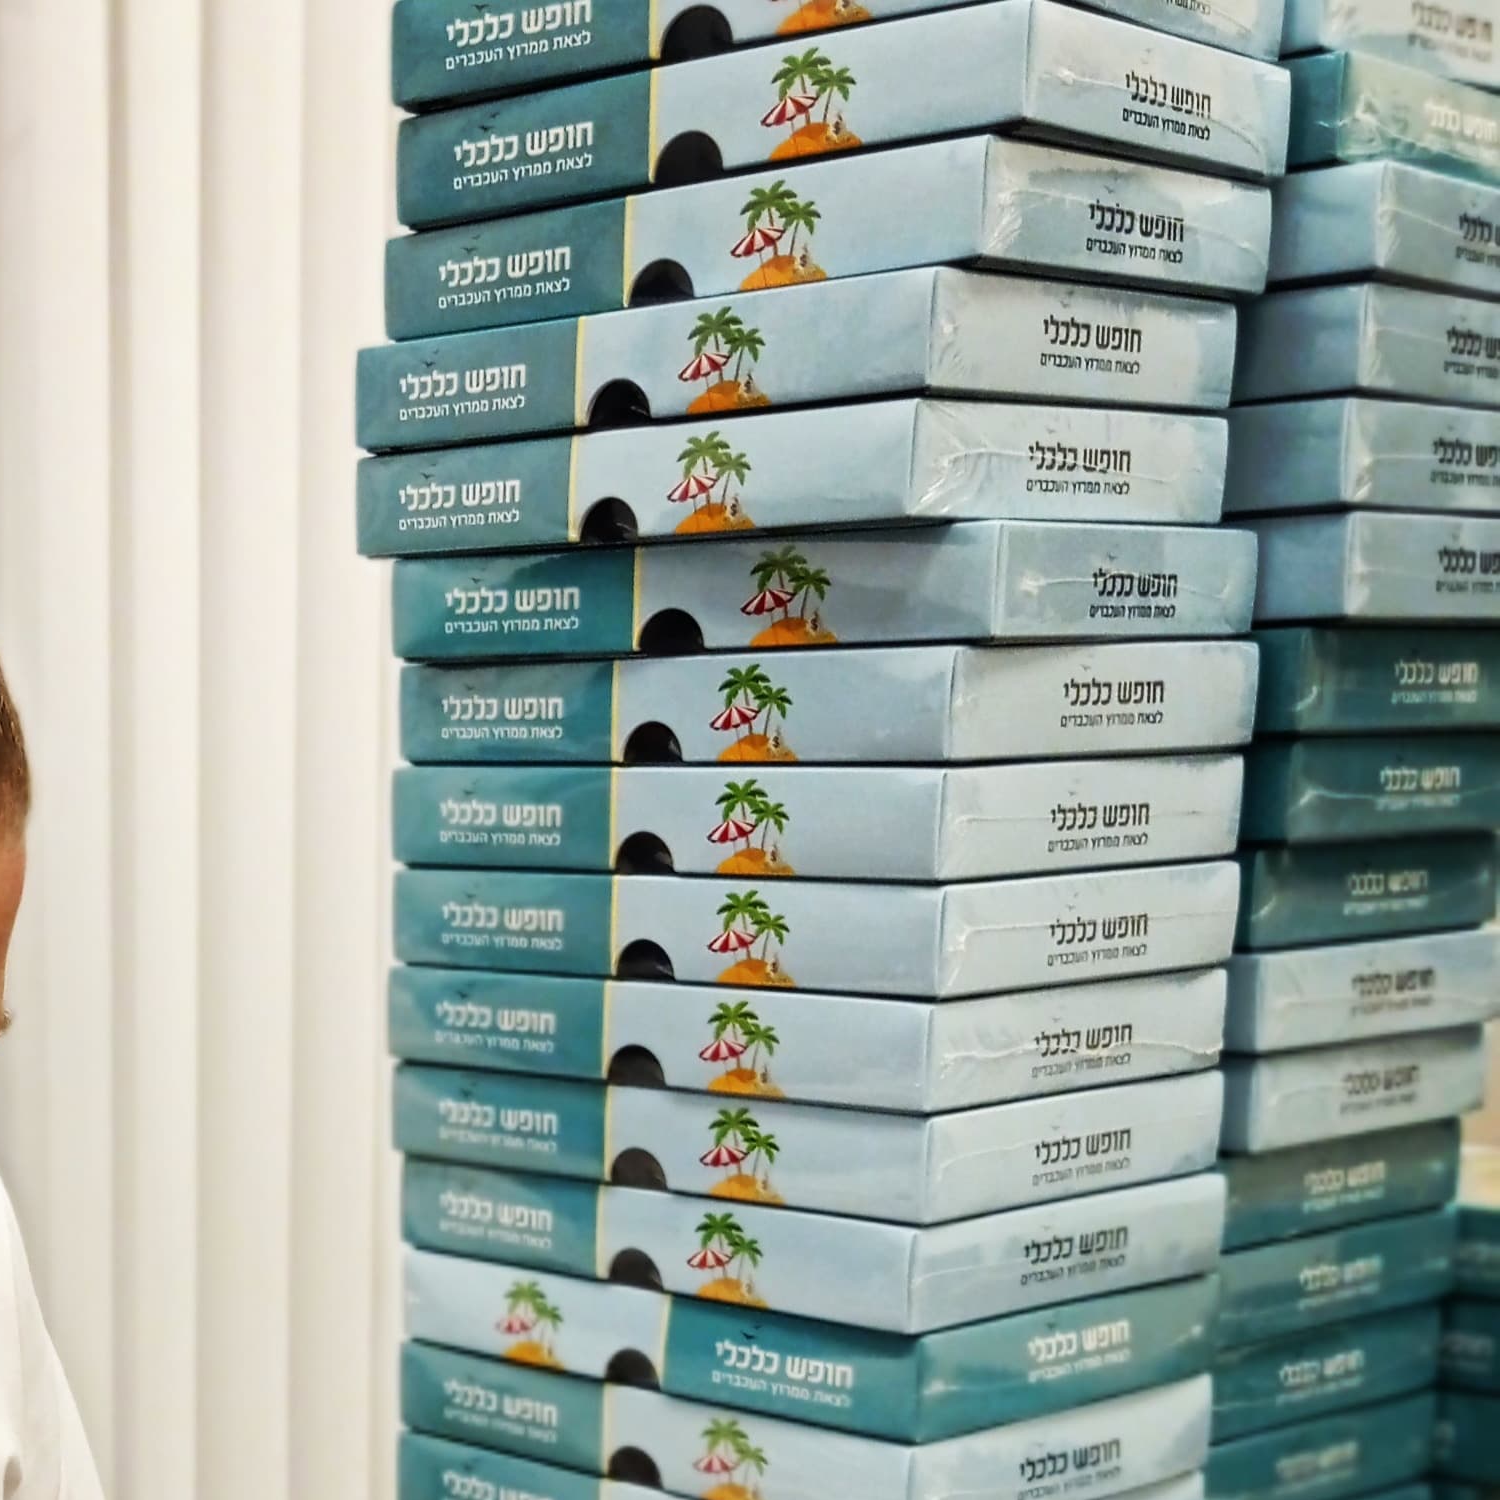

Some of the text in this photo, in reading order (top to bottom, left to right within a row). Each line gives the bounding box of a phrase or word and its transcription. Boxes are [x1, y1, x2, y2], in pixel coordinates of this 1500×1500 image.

[447, 0, 591, 47] חופש כלכלי
[446, 30, 590, 70] לצאת ממרוץ העכברים
[454, 121, 593, 168] חופש כלכלי
[454, 153, 592, 190] לצאת ממרוץ העכברים
[439, 246, 570, 287] חופש כלכלי
[1044, 315, 1141, 353] חופש כלכלי
[400, 364, 525, 400] חופש כלכלי
[400, 393, 524, 420] לצאת ממרוץ העכברים
[1029, 441, 1130, 474] חופש כלכלי
[399, 479, 520, 511] חופש כלכלי
[445, 585, 579, 614] חופש כלכלי
[442, 695, 563, 720] חופש כלכלי
[1064, 677, 1164, 706] חופש כלכלי
[440, 798, 561, 827] חופש כלכלי
[1051, 802, 1149, 831] חופש כלכלי
[442, 901, 563, 931] חופש כלכלי
[1050, 914, 1148, 946] חופש כלכלי
[436, 1000, 555, 1034] חופש כלכלי
[1035, 1128, 1130, 1165] חופש כלכלי
[716, 1340, 852, 1388] חופש כלכלי
